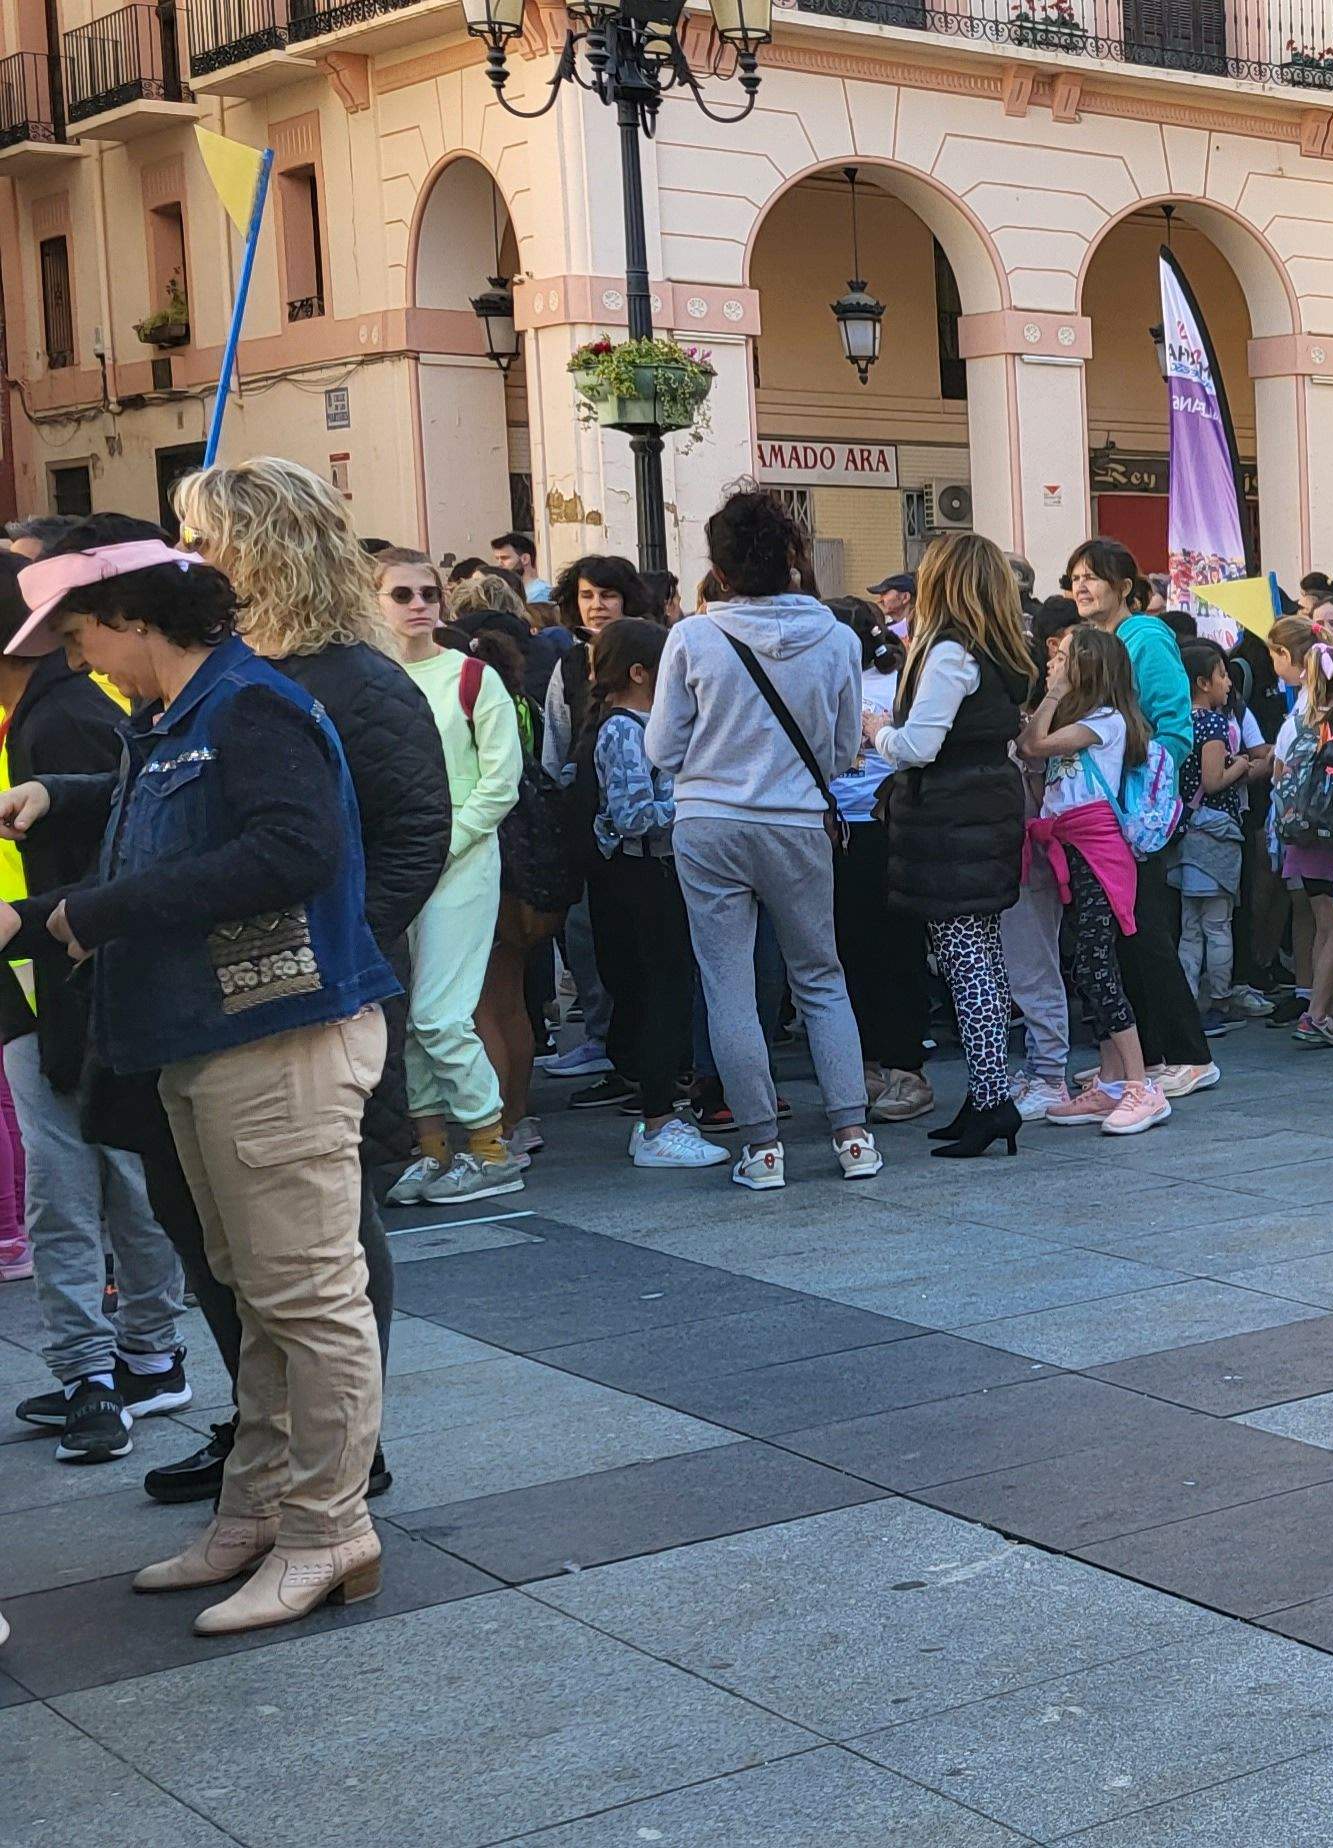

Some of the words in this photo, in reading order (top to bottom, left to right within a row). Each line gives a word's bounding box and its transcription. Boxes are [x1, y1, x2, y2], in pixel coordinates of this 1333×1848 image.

[757, 444, 836, 470] AMADO
[844, 448, 890, 472] ARA
[1092, 462, 1156, 488] Rey
